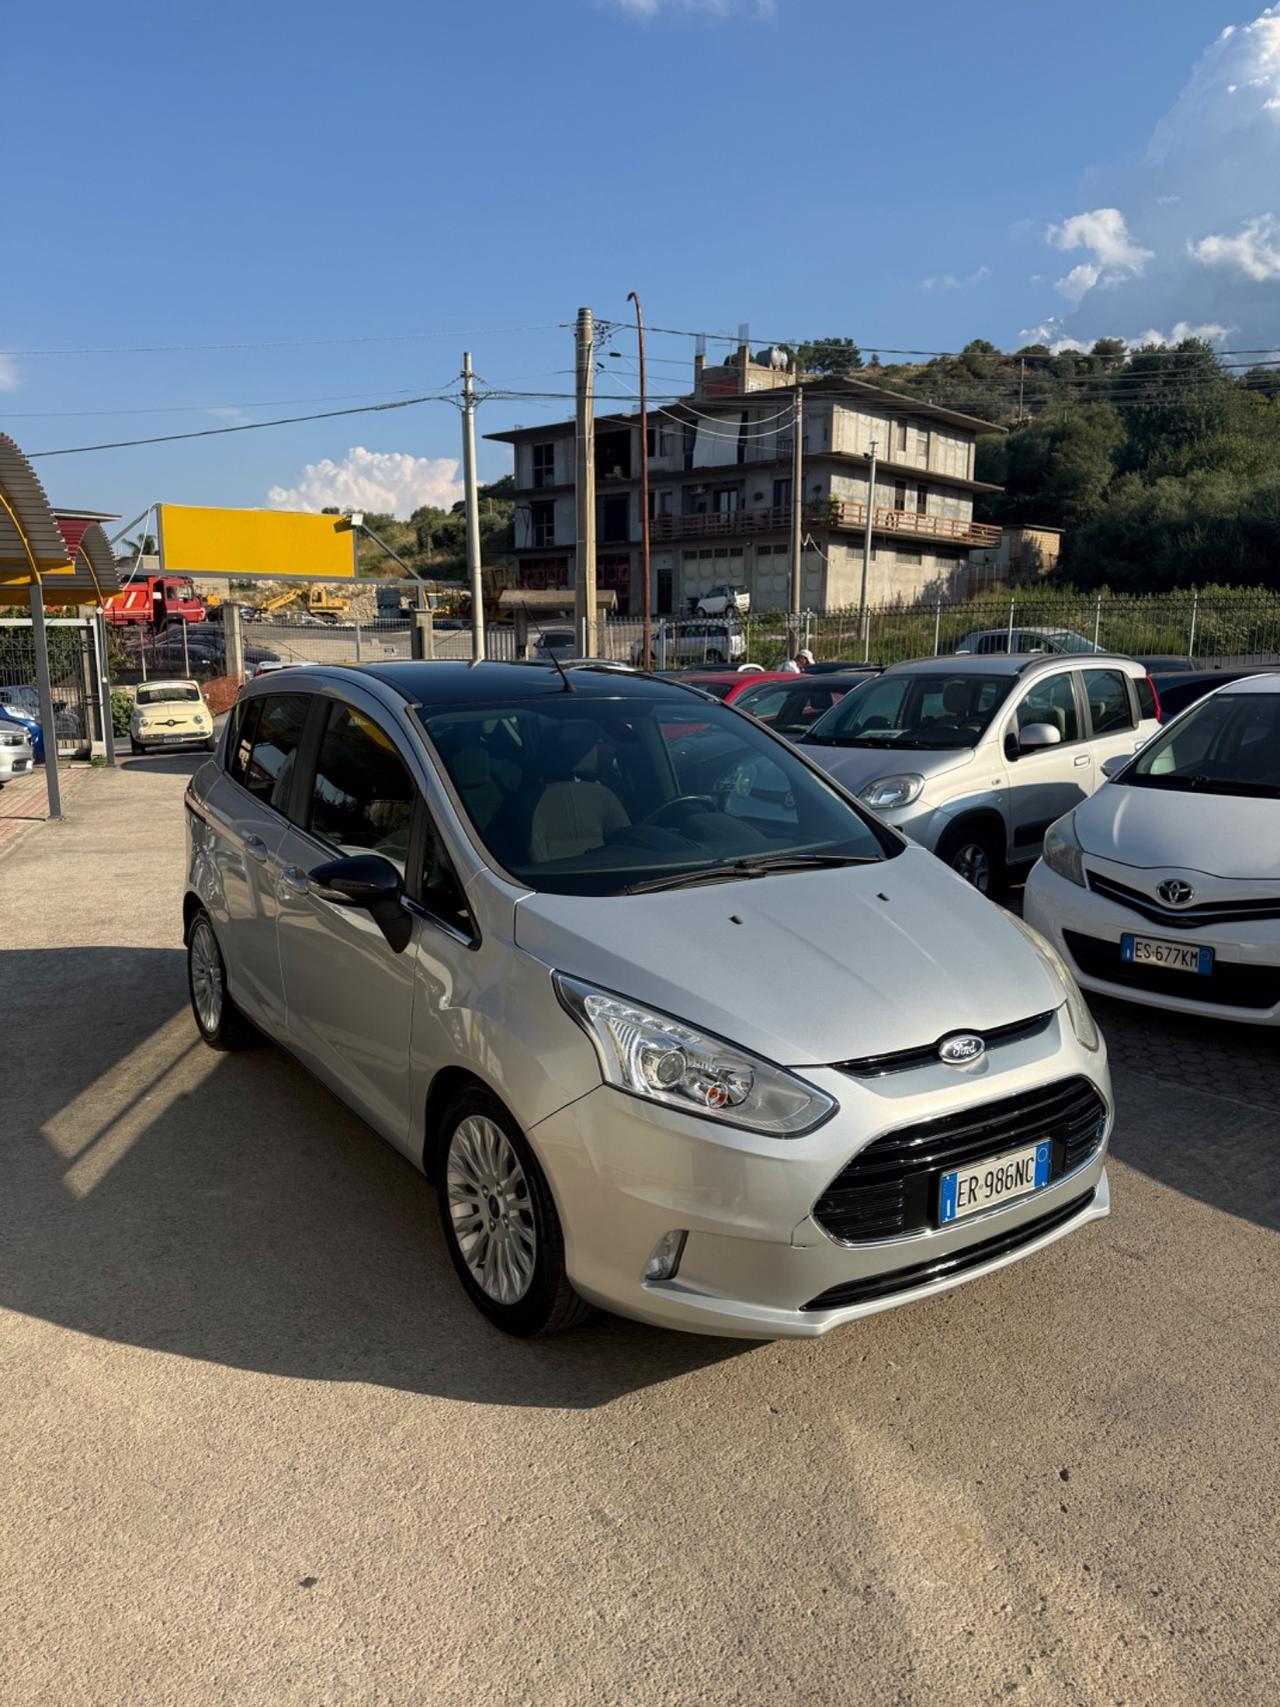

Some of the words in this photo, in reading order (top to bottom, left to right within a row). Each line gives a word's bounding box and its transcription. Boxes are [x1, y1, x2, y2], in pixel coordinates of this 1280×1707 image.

[1135, 942, 1151, 959] ES
[1156, 945, 1198, 968] 677KM
[953, 1040, 976, 1057] Ford
[957, 1176, 979, 1208] ER
[985, 1157, 1035, 1198] 986NC
